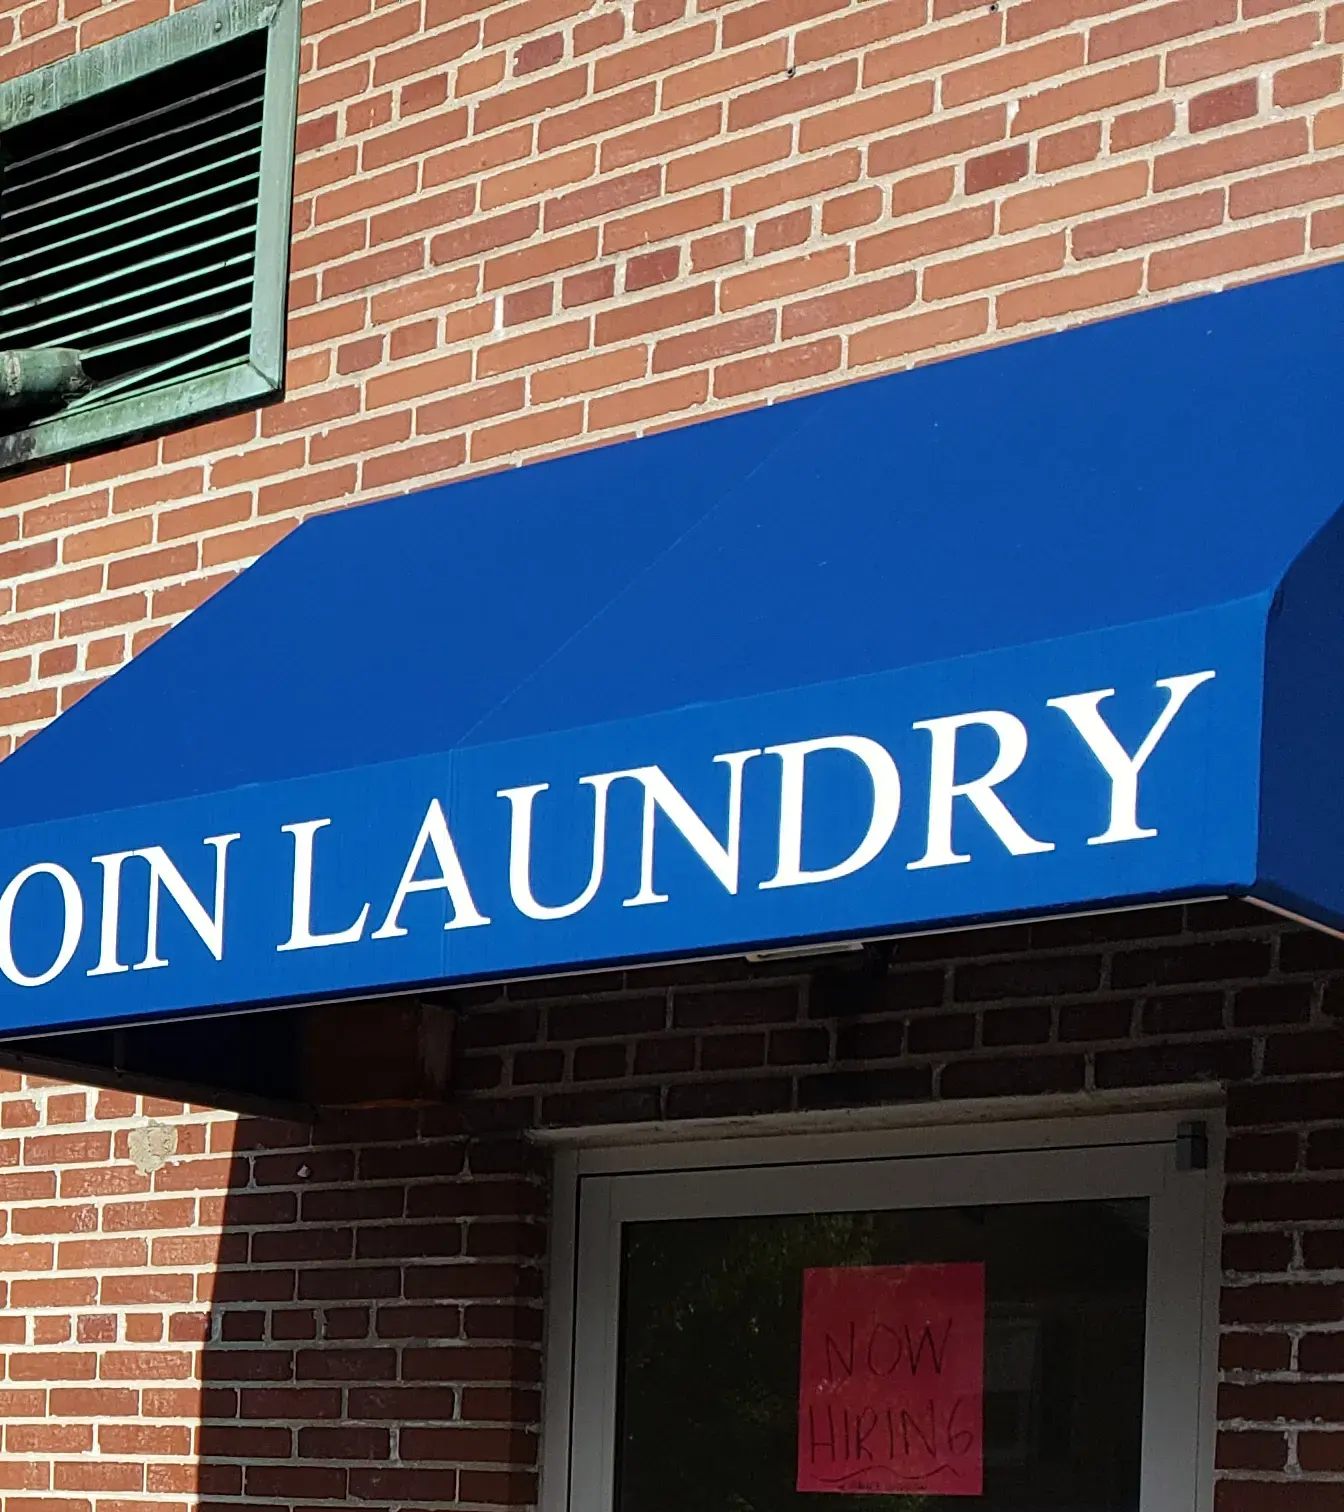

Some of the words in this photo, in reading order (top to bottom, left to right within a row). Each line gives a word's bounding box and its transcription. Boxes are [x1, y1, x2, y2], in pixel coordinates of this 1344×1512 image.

[276, 670, 1216, 952] LAUNDRY
[826, 1318, 953, 1382] NOW
[809, 1398, 974, 1464] HIRING
